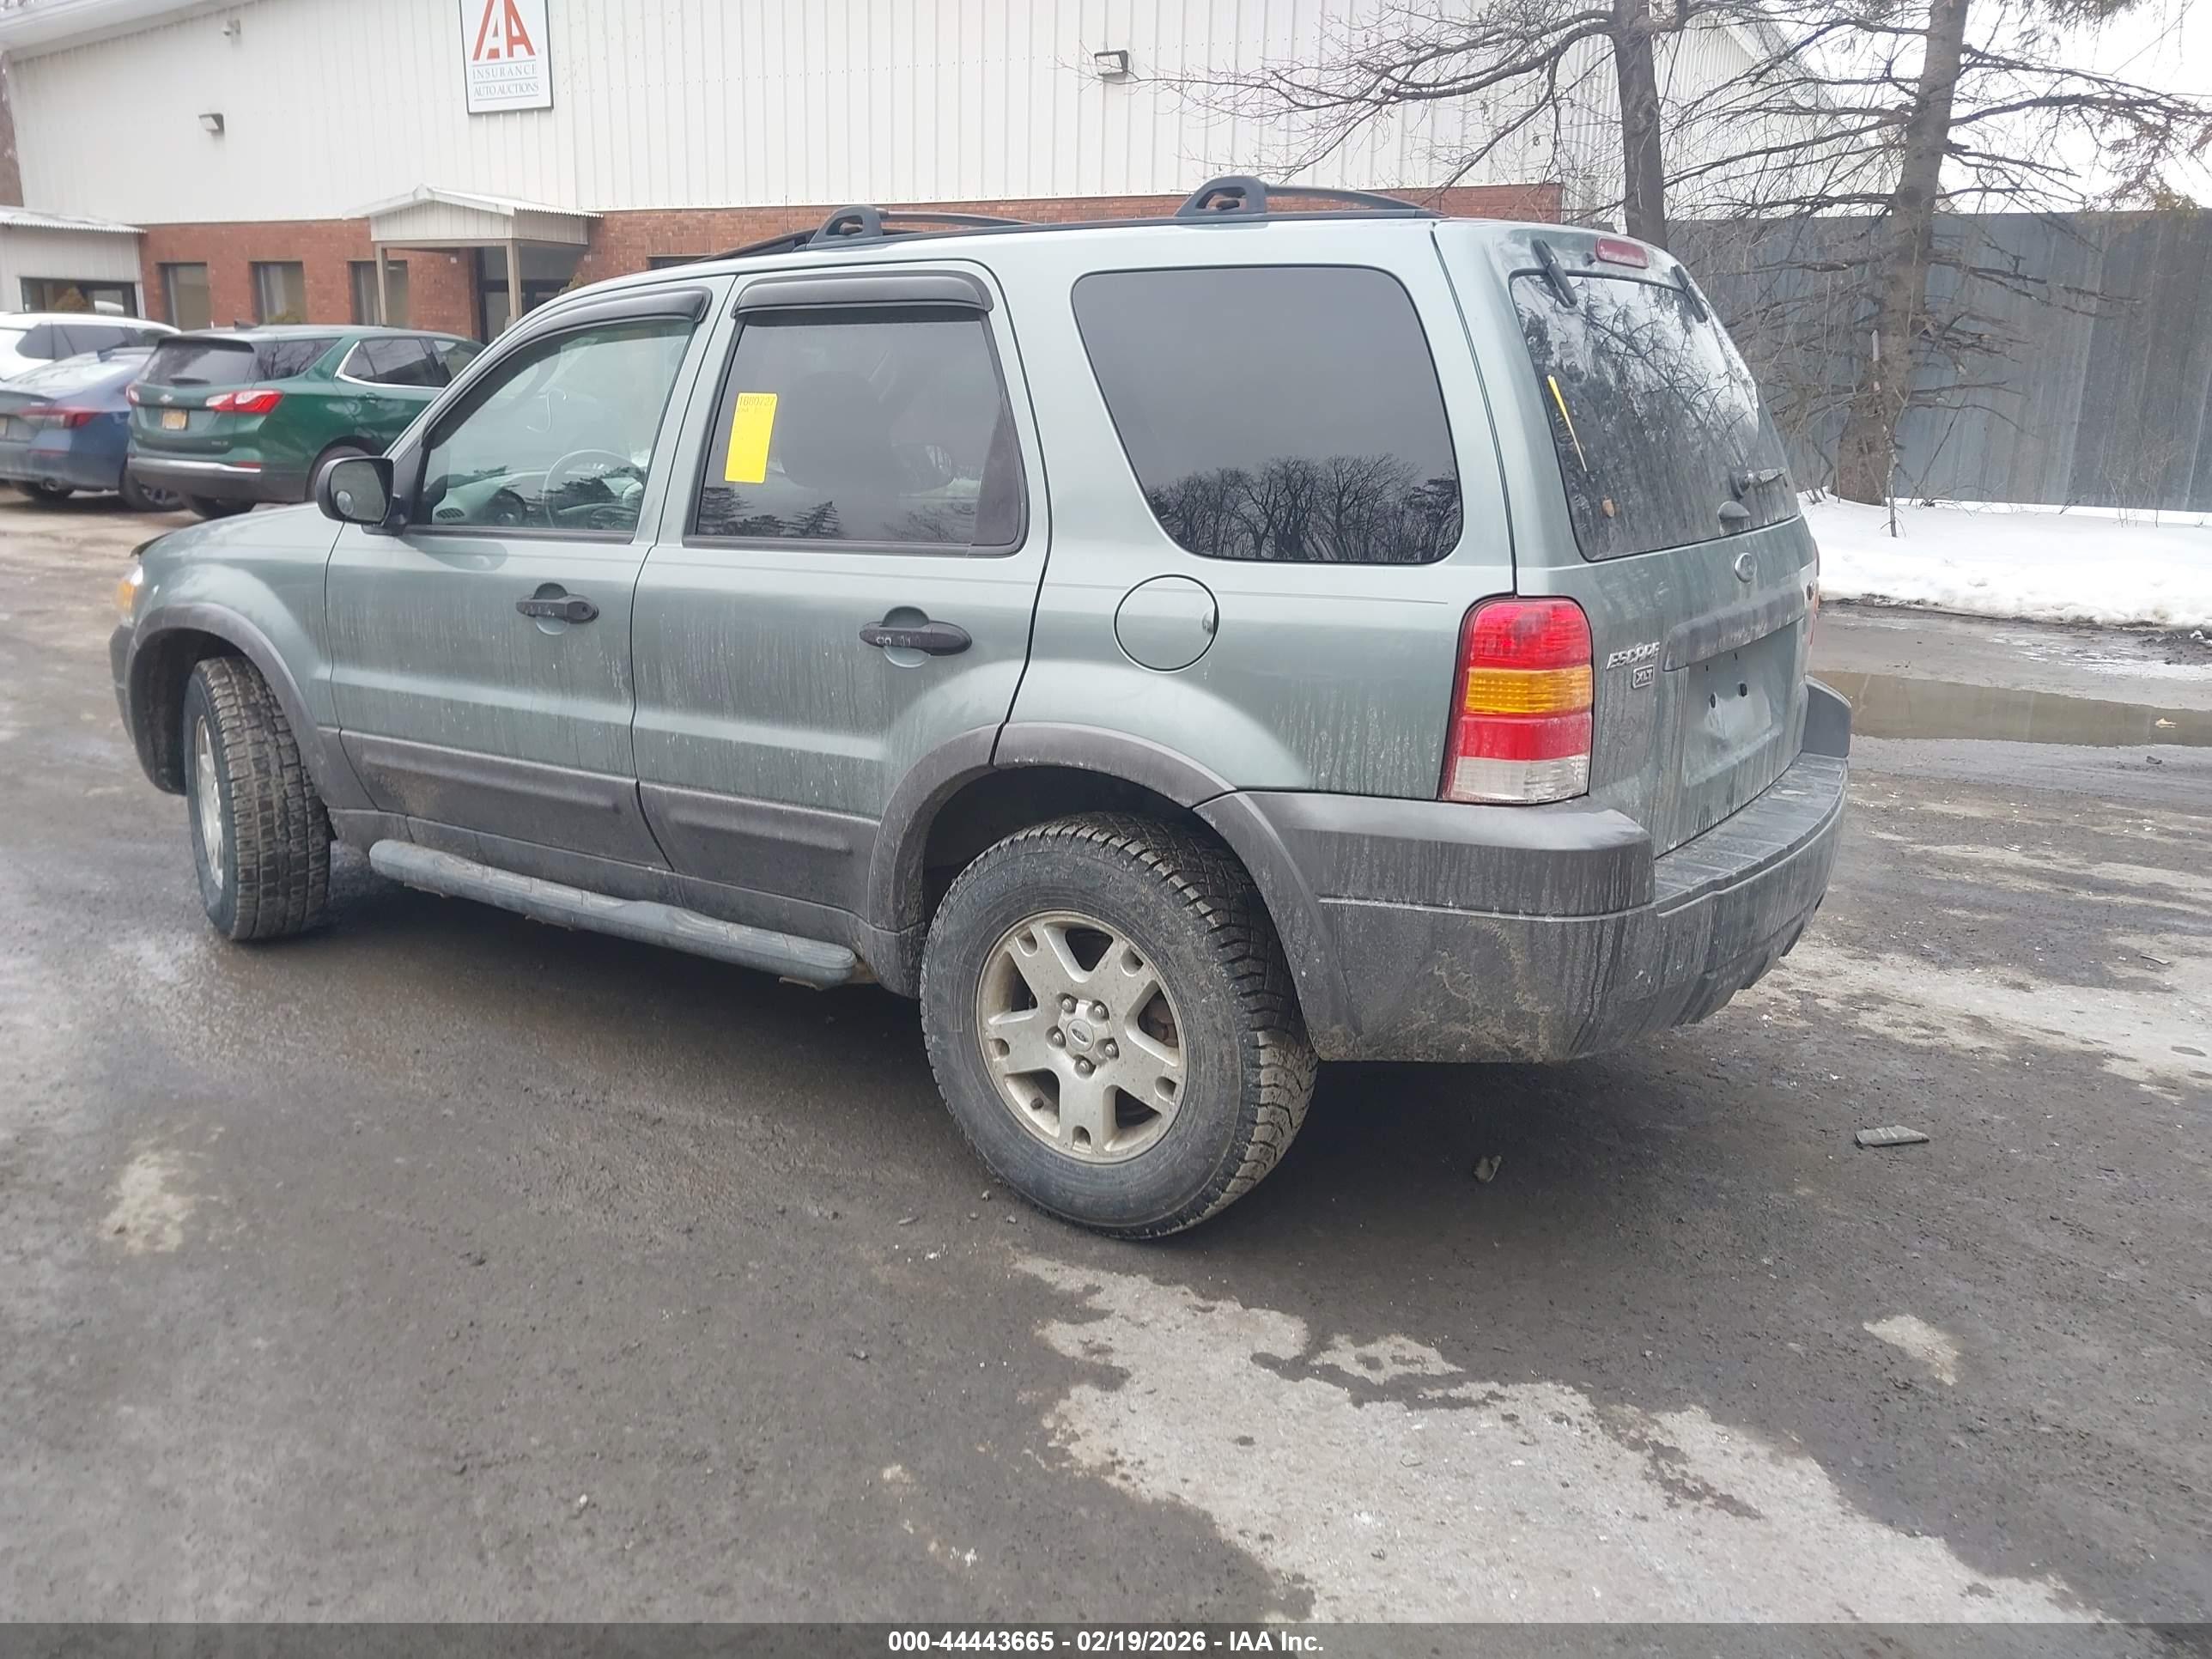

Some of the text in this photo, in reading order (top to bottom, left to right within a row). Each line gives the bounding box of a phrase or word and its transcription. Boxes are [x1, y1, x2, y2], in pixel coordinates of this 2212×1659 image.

[472, 64, 537, 80] INSURANCE
[474, 82, 539, 97] AUTO AUCTIONS
[1606, 641, 1661, 670] ESCAPE
[1635, 668, 1654, 684] XLT
